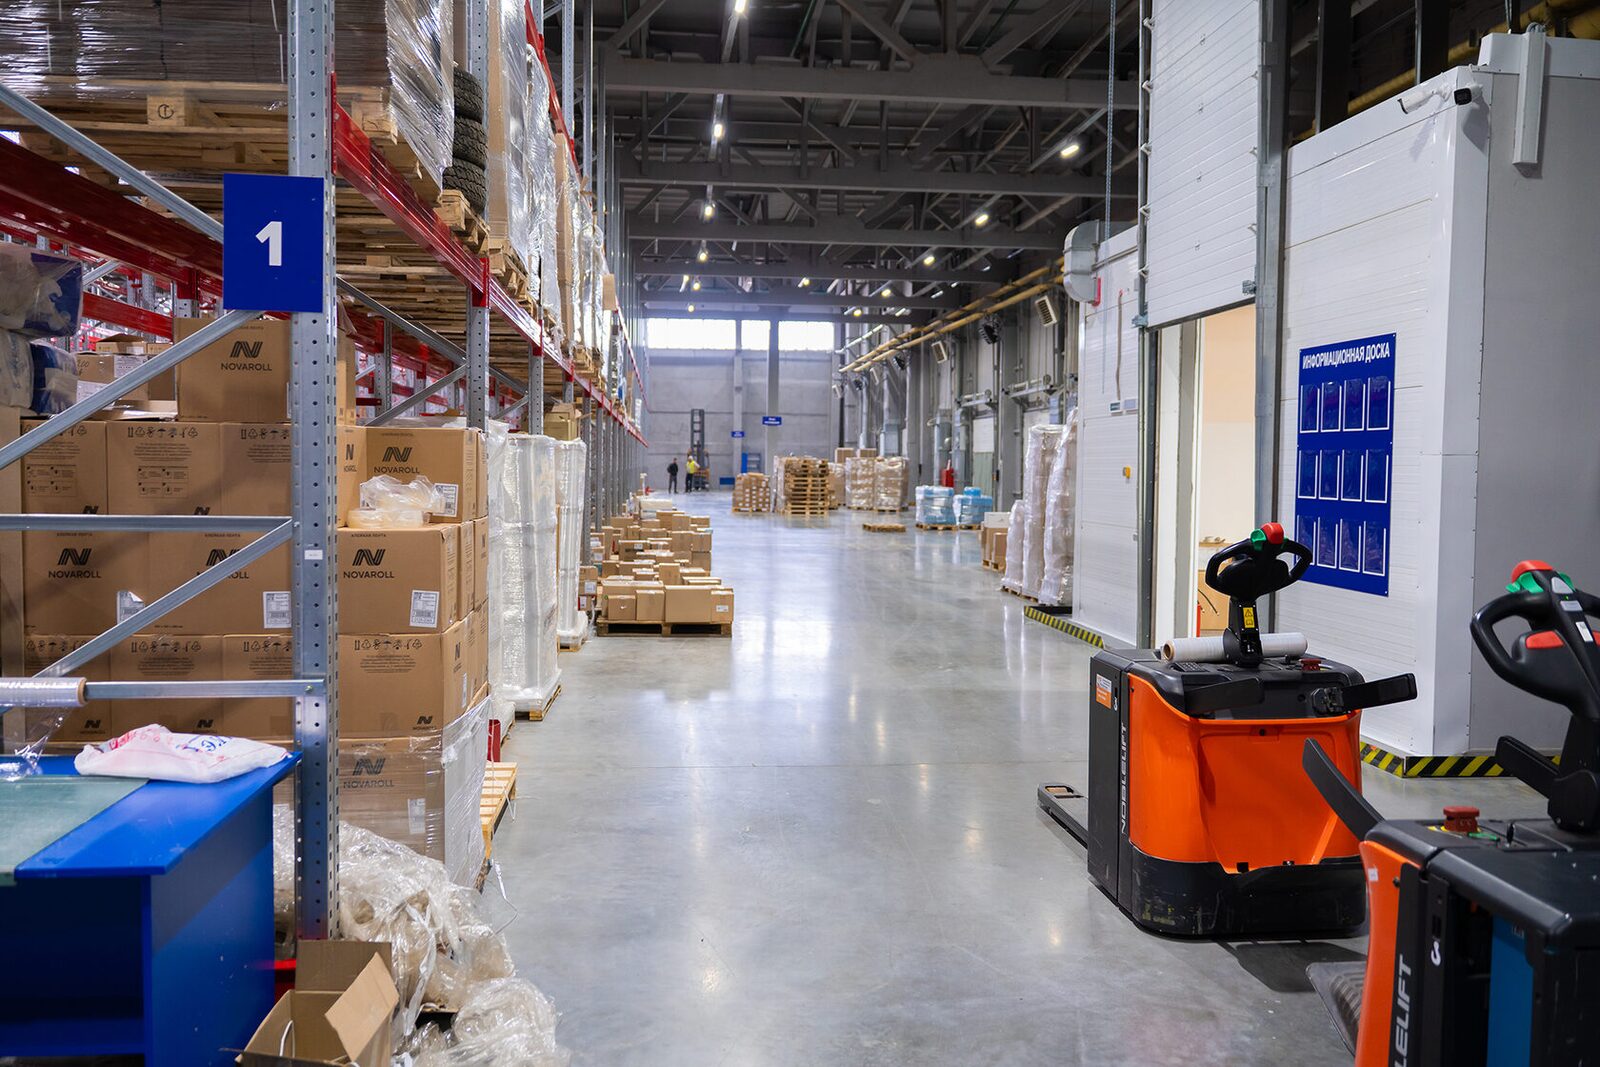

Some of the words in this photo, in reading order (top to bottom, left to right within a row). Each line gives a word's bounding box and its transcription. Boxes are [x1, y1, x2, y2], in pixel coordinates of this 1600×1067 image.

[256, 221, 283, 267] 1
[1302, 346, 1365, 370] ИНФОРМАЦИОННАЯ
[1365, 342, 1391, 363] ДОСКА
[220, 362, 273, 371] NOVAROLL
[373, 466, 421, 474] NOVAROLL
[48, 570, 102, 579] NOVAROLL
[343, 571, 395, 579] NOVAROLL
[1121, 722, 1129, 835] NOBLELIFT
[343, 779, 395, 789] NOVAROLL
